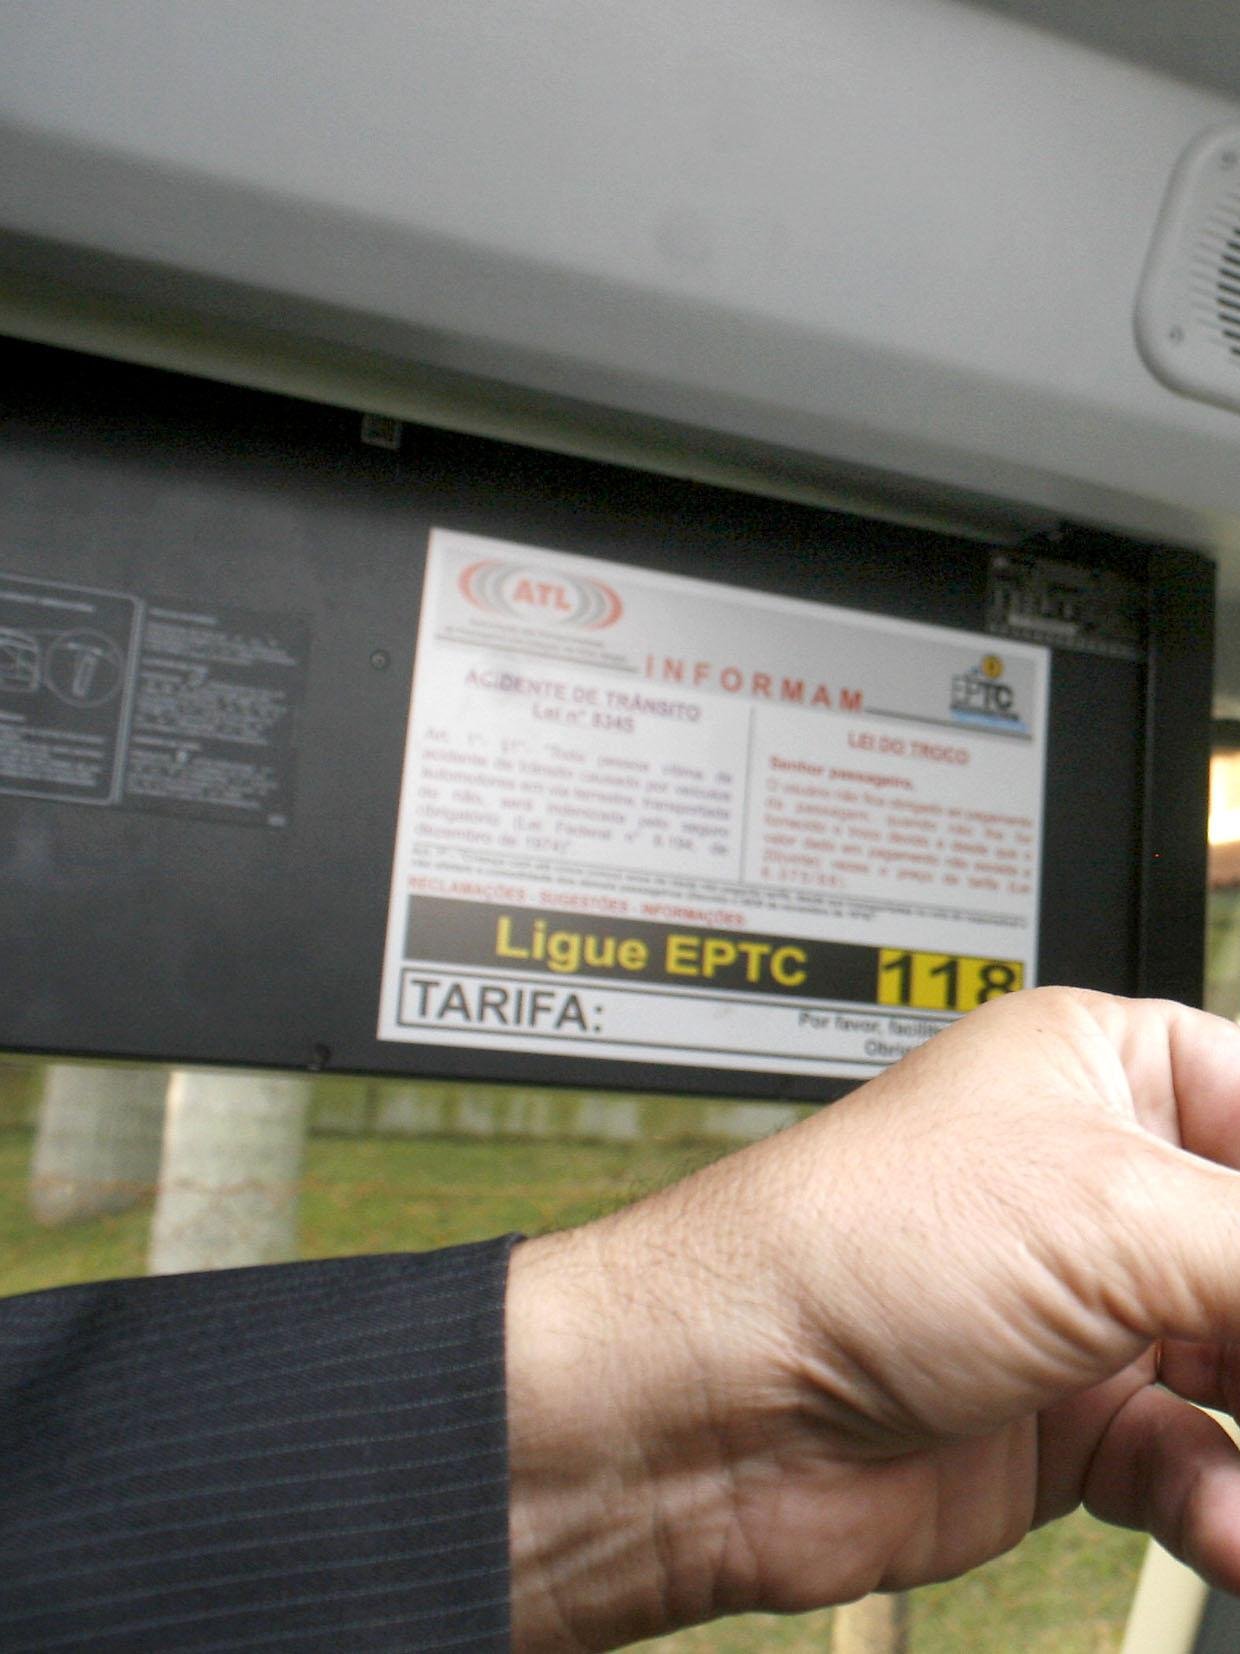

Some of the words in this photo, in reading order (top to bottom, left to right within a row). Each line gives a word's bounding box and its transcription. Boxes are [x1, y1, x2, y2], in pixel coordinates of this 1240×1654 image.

[513, 578, 571, 612] ATL
[465, 669, 567, 700] ACIDENTE
[644, 655, 864, 712] INFORMAM
[496, 914, 650, 975] Ligue
[664, 933, 808, 988] EPTC
[881, 951, 1017, 1010] 118
[411, 978, 604, 1034] TARIFA:
[798, 1010, 830, 1031] Por
[864, 1039, 912, 1059] Obri
